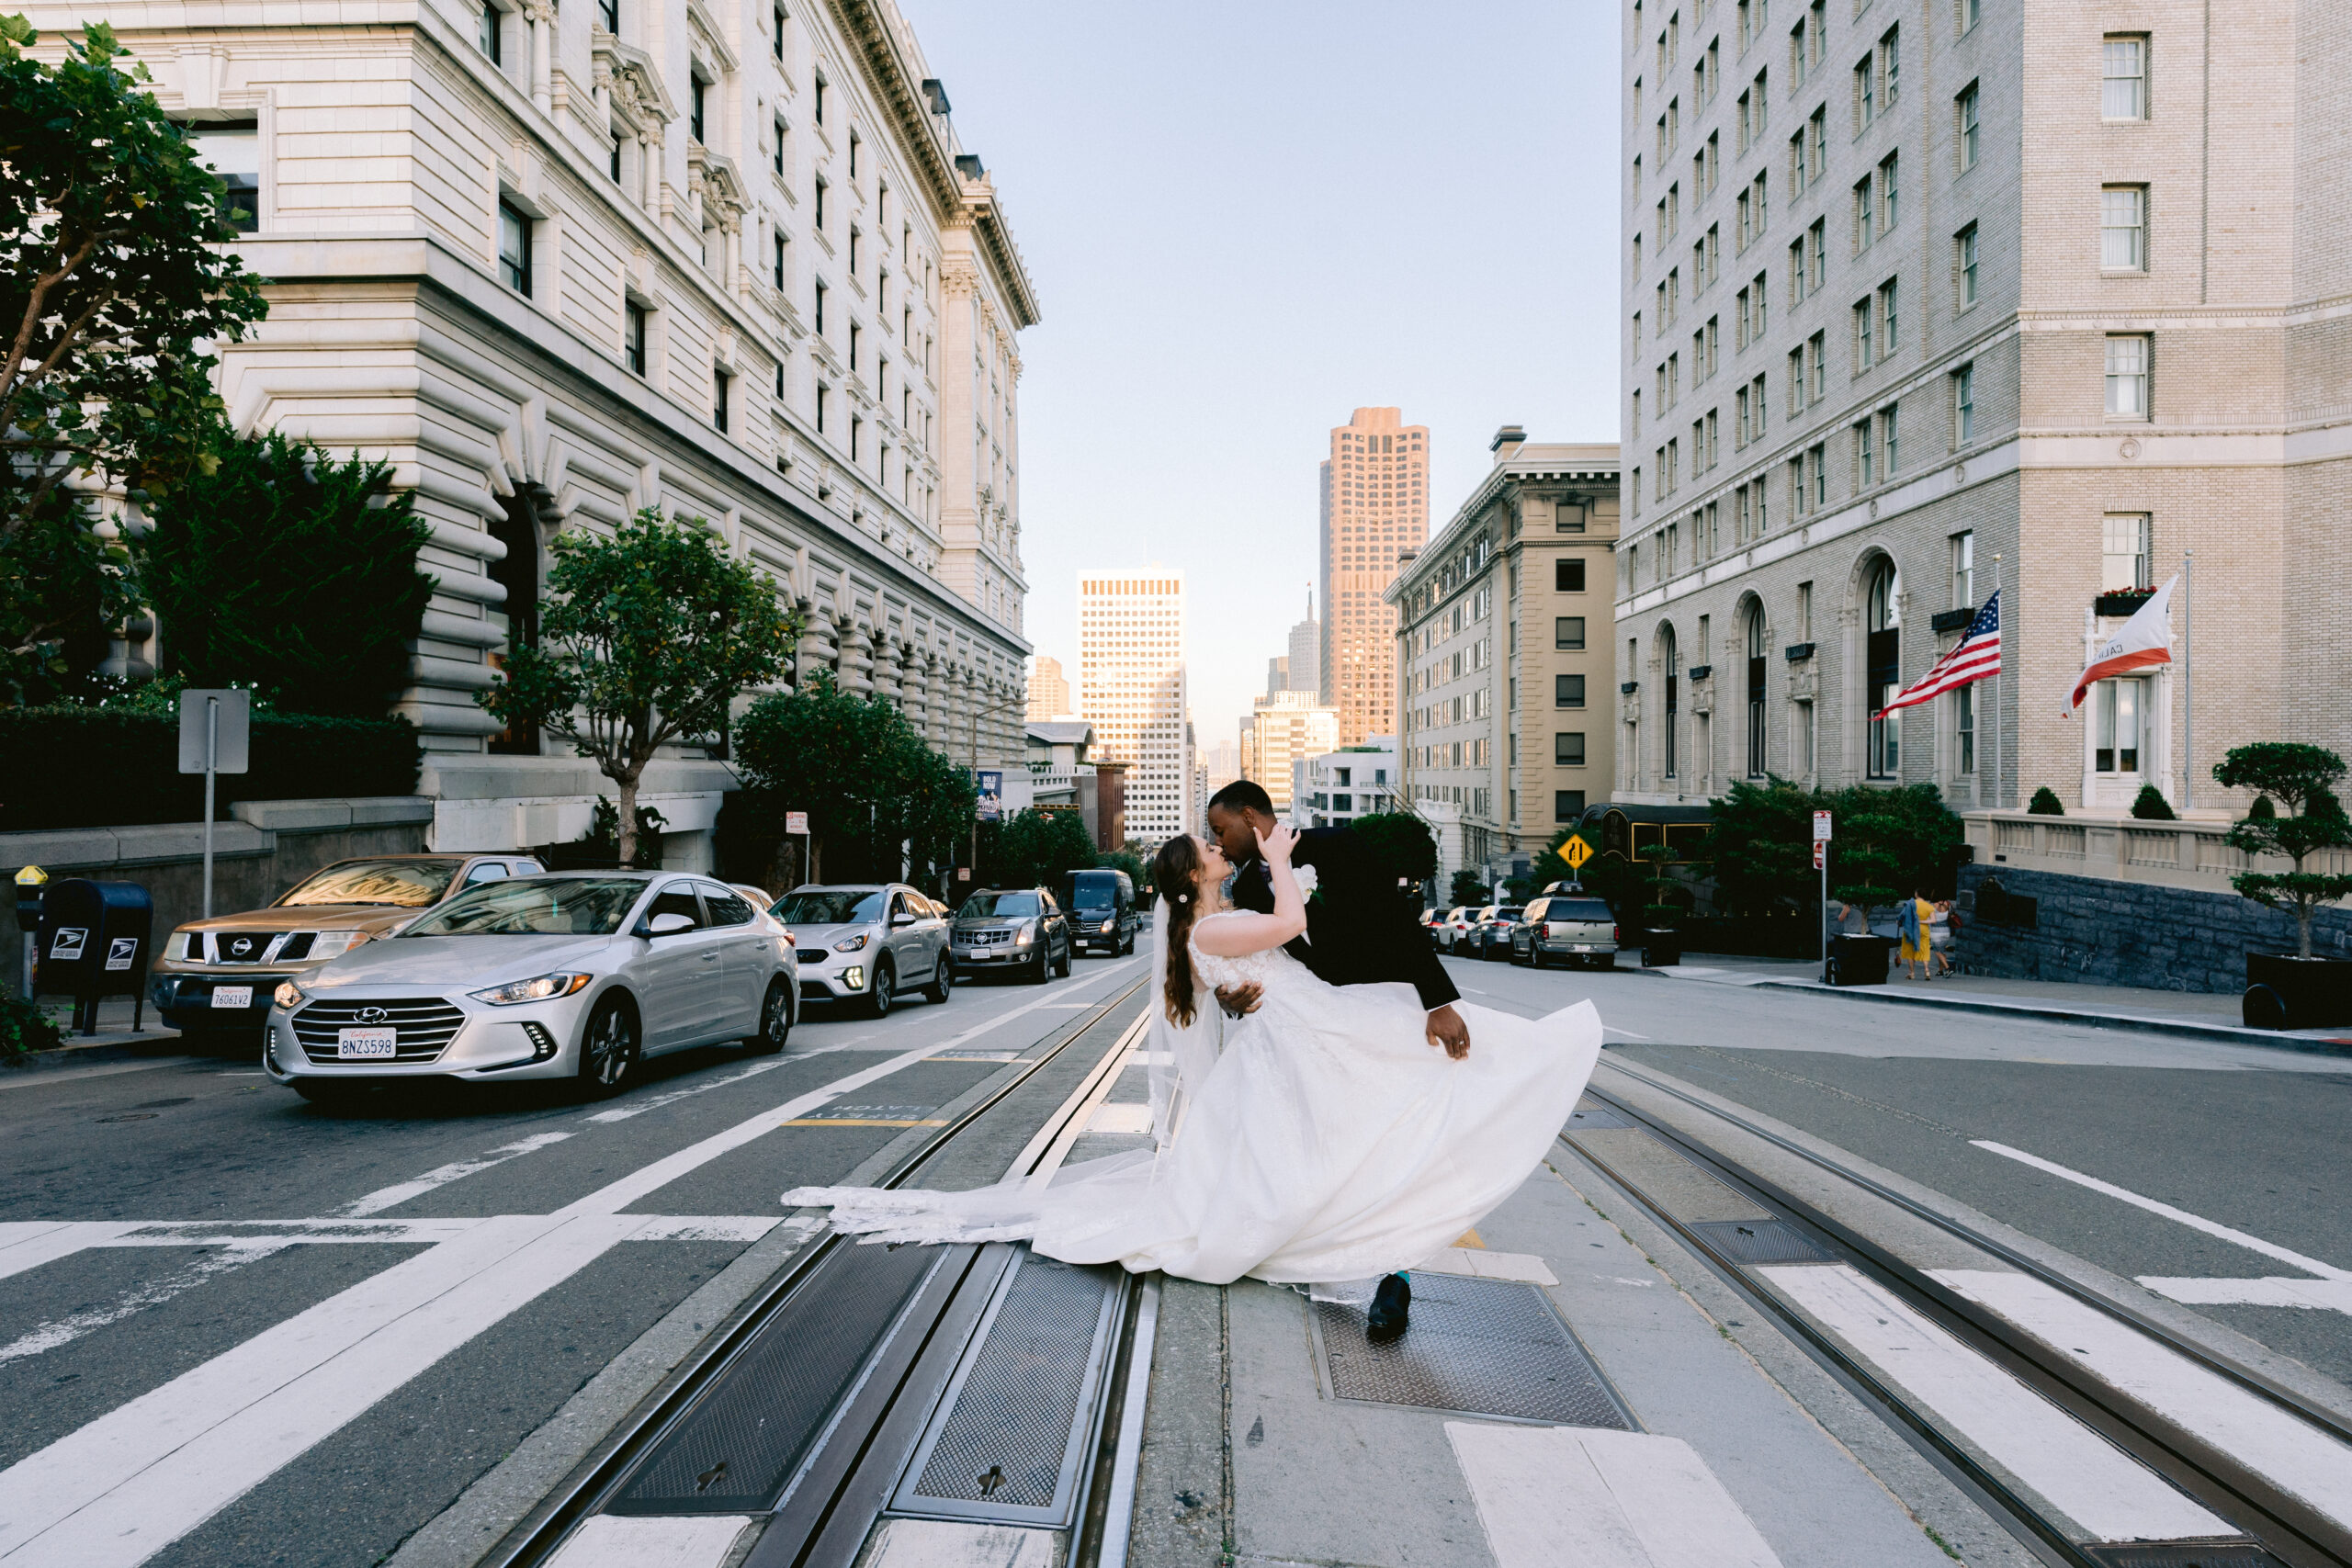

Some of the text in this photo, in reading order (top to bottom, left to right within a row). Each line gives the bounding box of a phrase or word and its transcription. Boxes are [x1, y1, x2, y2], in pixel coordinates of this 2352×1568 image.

[215, 994, 248, 1005] 76061V2
[350, 1030, 383, 1039] California
[342, 1039, 391, 1055] 8NZS598
